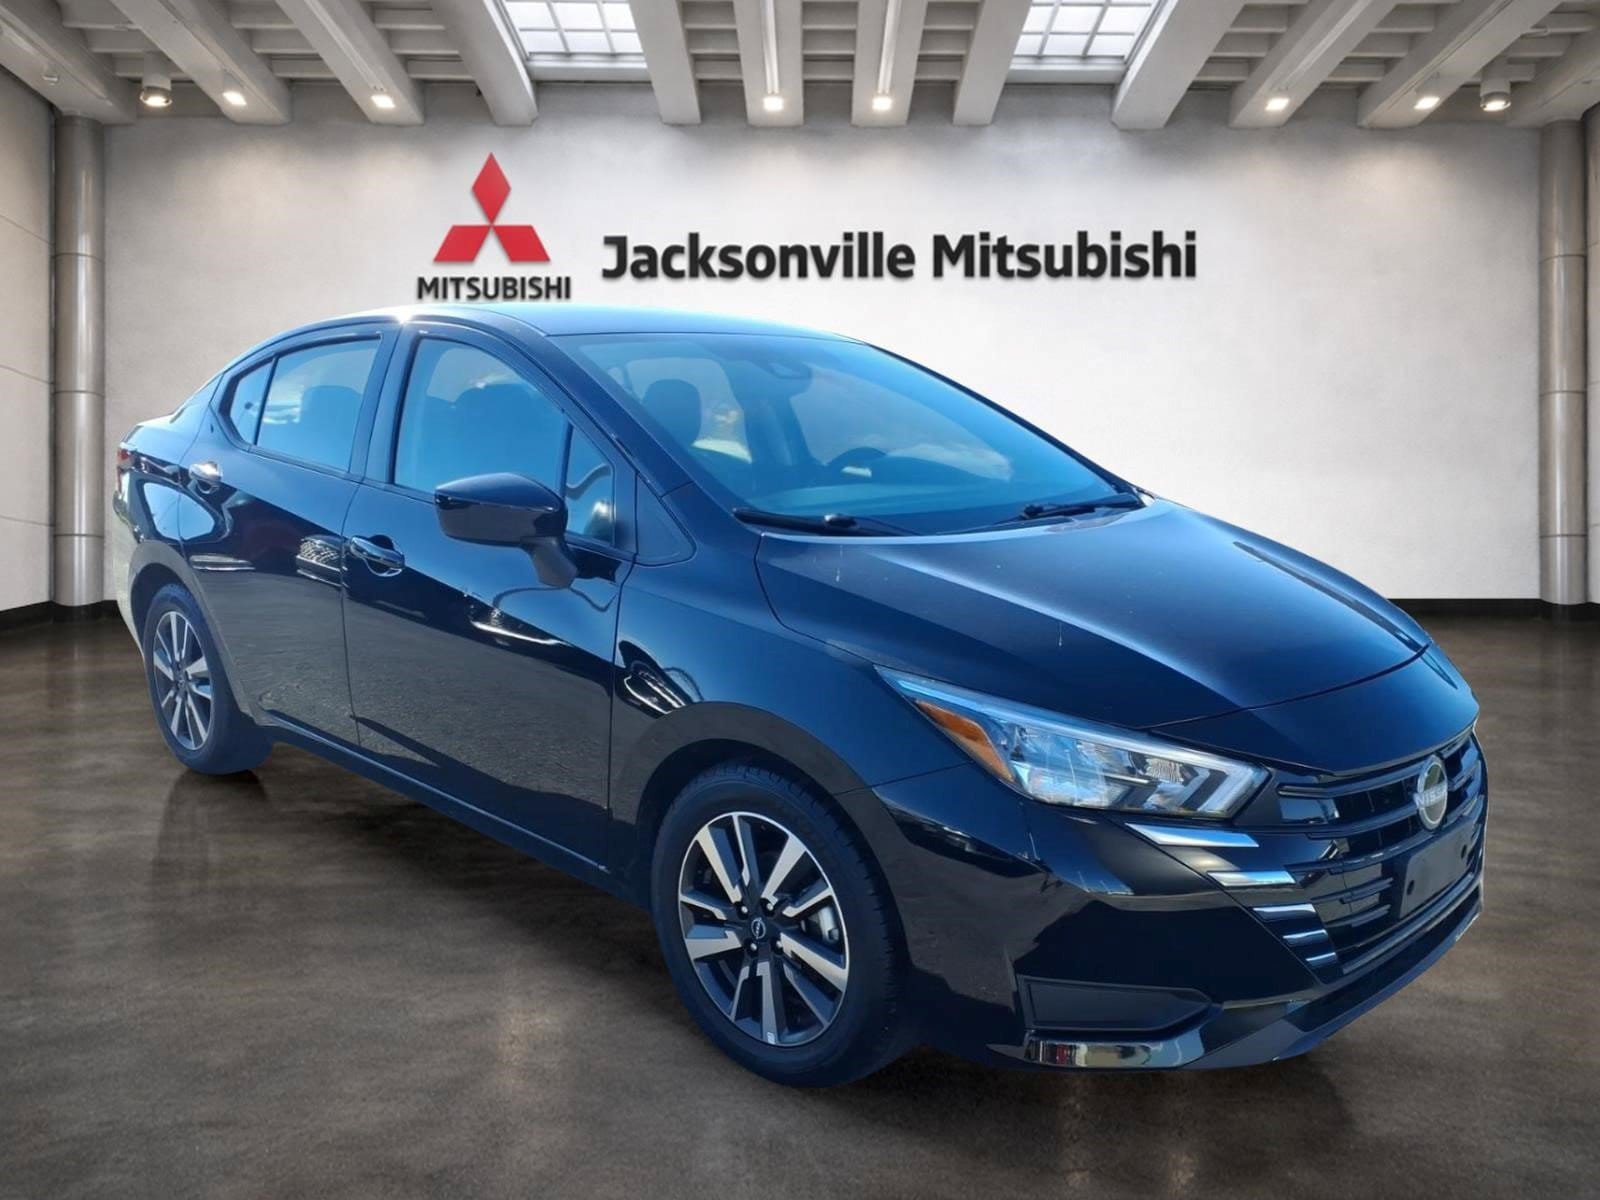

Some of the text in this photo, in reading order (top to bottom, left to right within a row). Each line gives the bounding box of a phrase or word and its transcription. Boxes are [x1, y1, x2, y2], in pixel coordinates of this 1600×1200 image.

[601, 230, 1196, 279] Jacksonville Mitsubishi
[417, 276, 571, 299] MITSUBISHI
